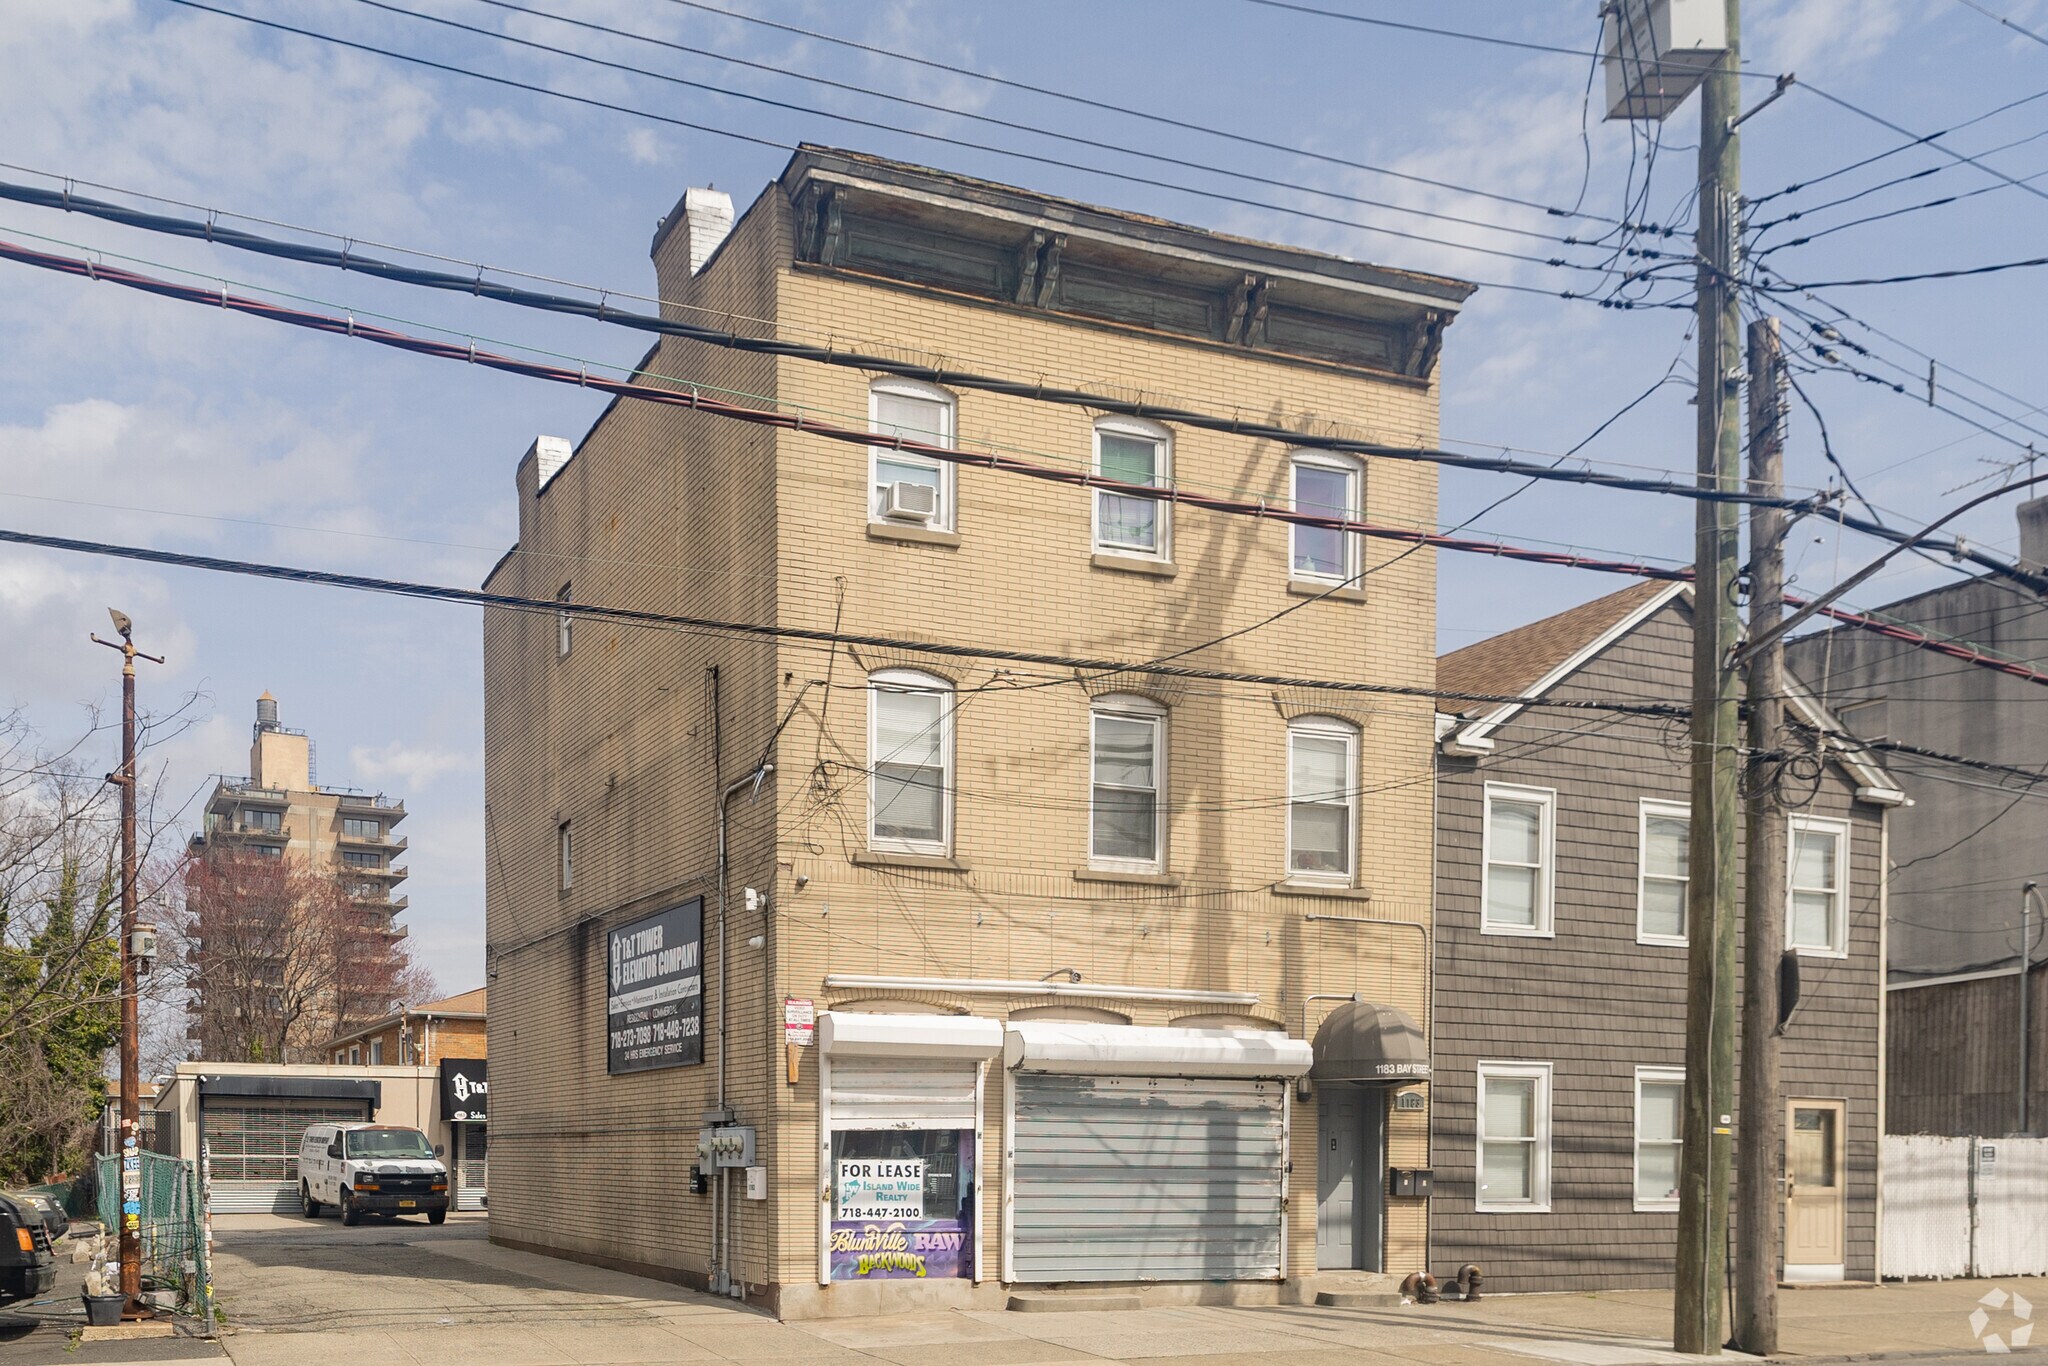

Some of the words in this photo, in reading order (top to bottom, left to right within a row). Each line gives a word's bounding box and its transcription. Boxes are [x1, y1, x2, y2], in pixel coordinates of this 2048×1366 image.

[622, 934, 636, 960] T&T
[636, 925, 663, 955] TOWER
[623, 954, 657, 985] ELEVATOR
[658, 941, 698, 976] COMPANY
[654, 989, 658, 1000] &
[652, 1016, 700, 1042] 718-448-7238
[624, 1051, 629, 1060] 24
[630, 1049, 639, 1060] HRS
[639, 1046, 664, 1058] EMERGENCY
[664, 1042, 683, 1055] SERVICE
[1376, 1064, 1396, 1074] 1183
[1397, 1064, 1412, 1074] BAY
[841, 1164, 872, 1177] FOR
[877, 1164, 921, 1178] LEASE
[842, 1207, 920, 1218] 718-447-2100
[913, 1232, 966, 1251] RAW
